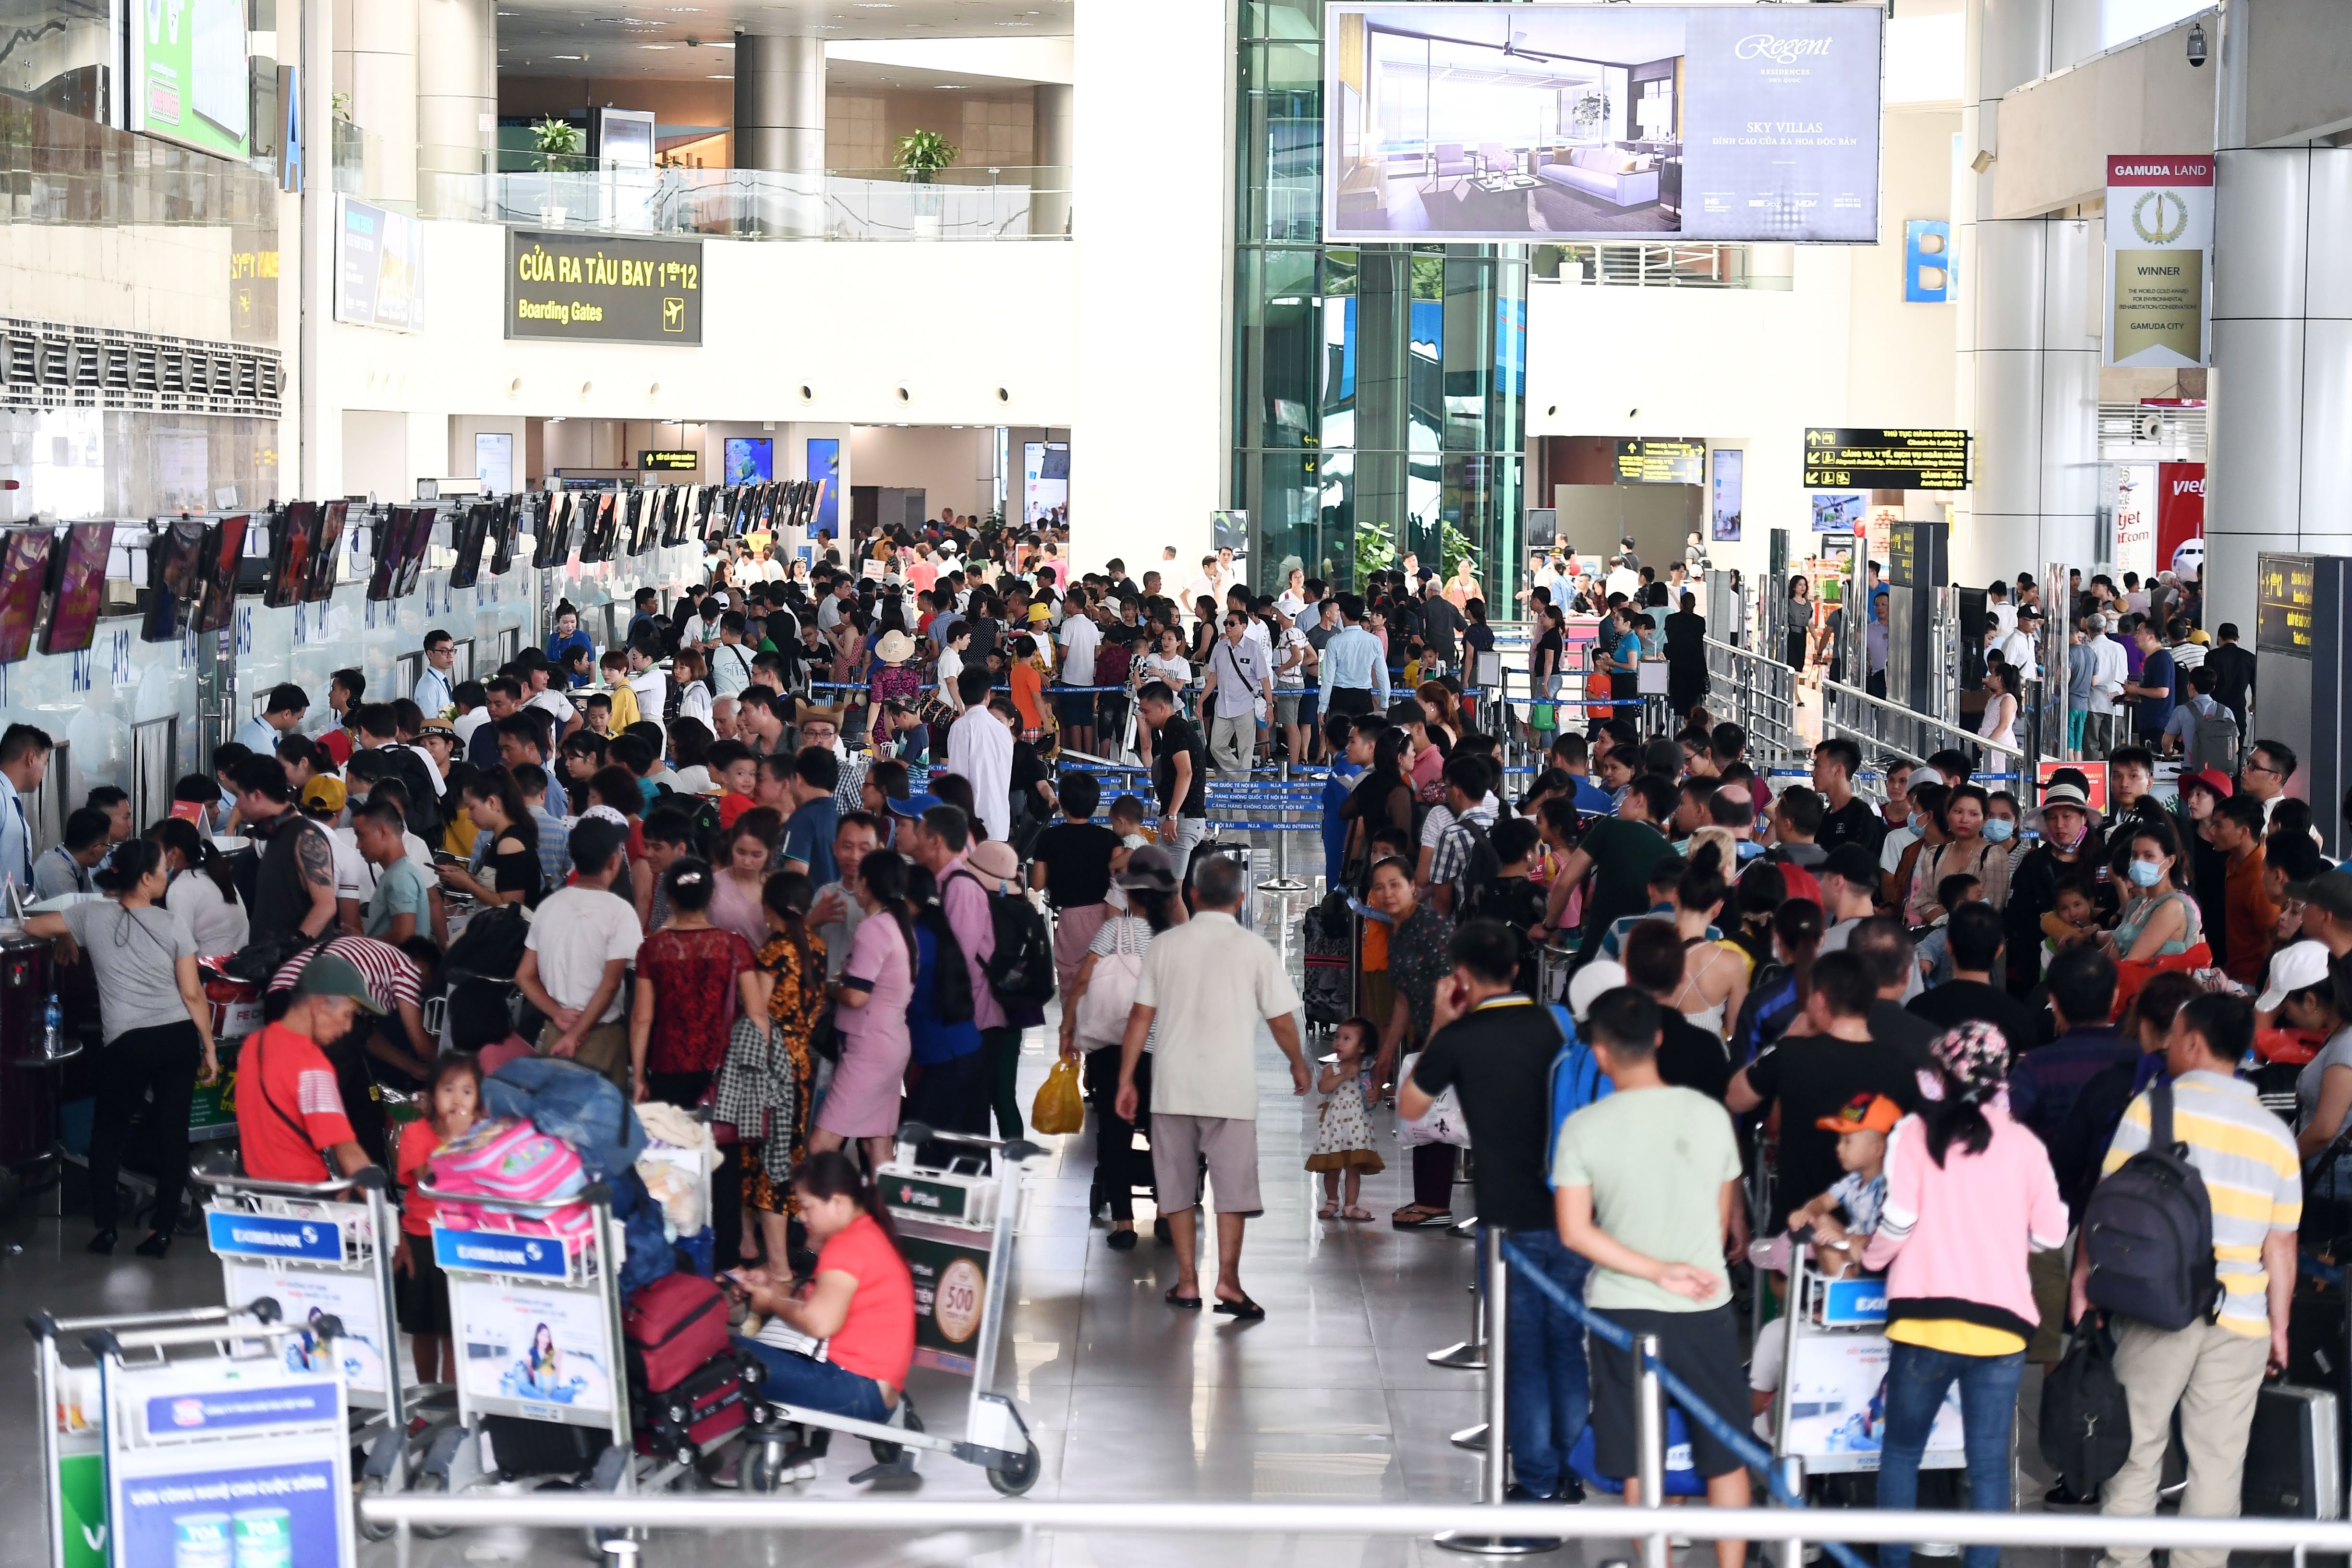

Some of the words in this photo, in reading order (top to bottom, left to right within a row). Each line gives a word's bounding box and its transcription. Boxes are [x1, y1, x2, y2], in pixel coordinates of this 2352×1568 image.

[1734, 34, 1834, 64] Regent
[284, 66, 302, 193] A
[1746, 122, 1772, 133] SKY
[1775, 122, 1823, 133] VILLAS
[1758, 136, 1778, 146] CỦA
[1816, 137, 1836, 146] ĐỘC
[1838, 136, 1857, 146] BẢN
[2115, 166, 2170, 176] GAMUDA
[2174, 165, 2207, 176] LAND
[519, 244, 555, 282] CỬA
[558, 255, 582, 284] RA
[585, 251, 618, 286] TÀU
[621, 259, 655, 287] BAY
[658, 262, 666, 288] 1
[680, 264, 698, 289] 12
[1905, 219, 1950, 303] B
[2137, 267, 2180, 276] WINNER
[519, 298, 570, 325] Boarding
[571, 301, 603, 322] Gates
[236, 607, 251, 656] A15
[294, 601, 306, 646] A16
[73, 649, 91, 693] A12
[111, 630, 129, 685] A13
[236, 1010, 250, 1021] FE
[946, 1287, 973, 1312] 500
